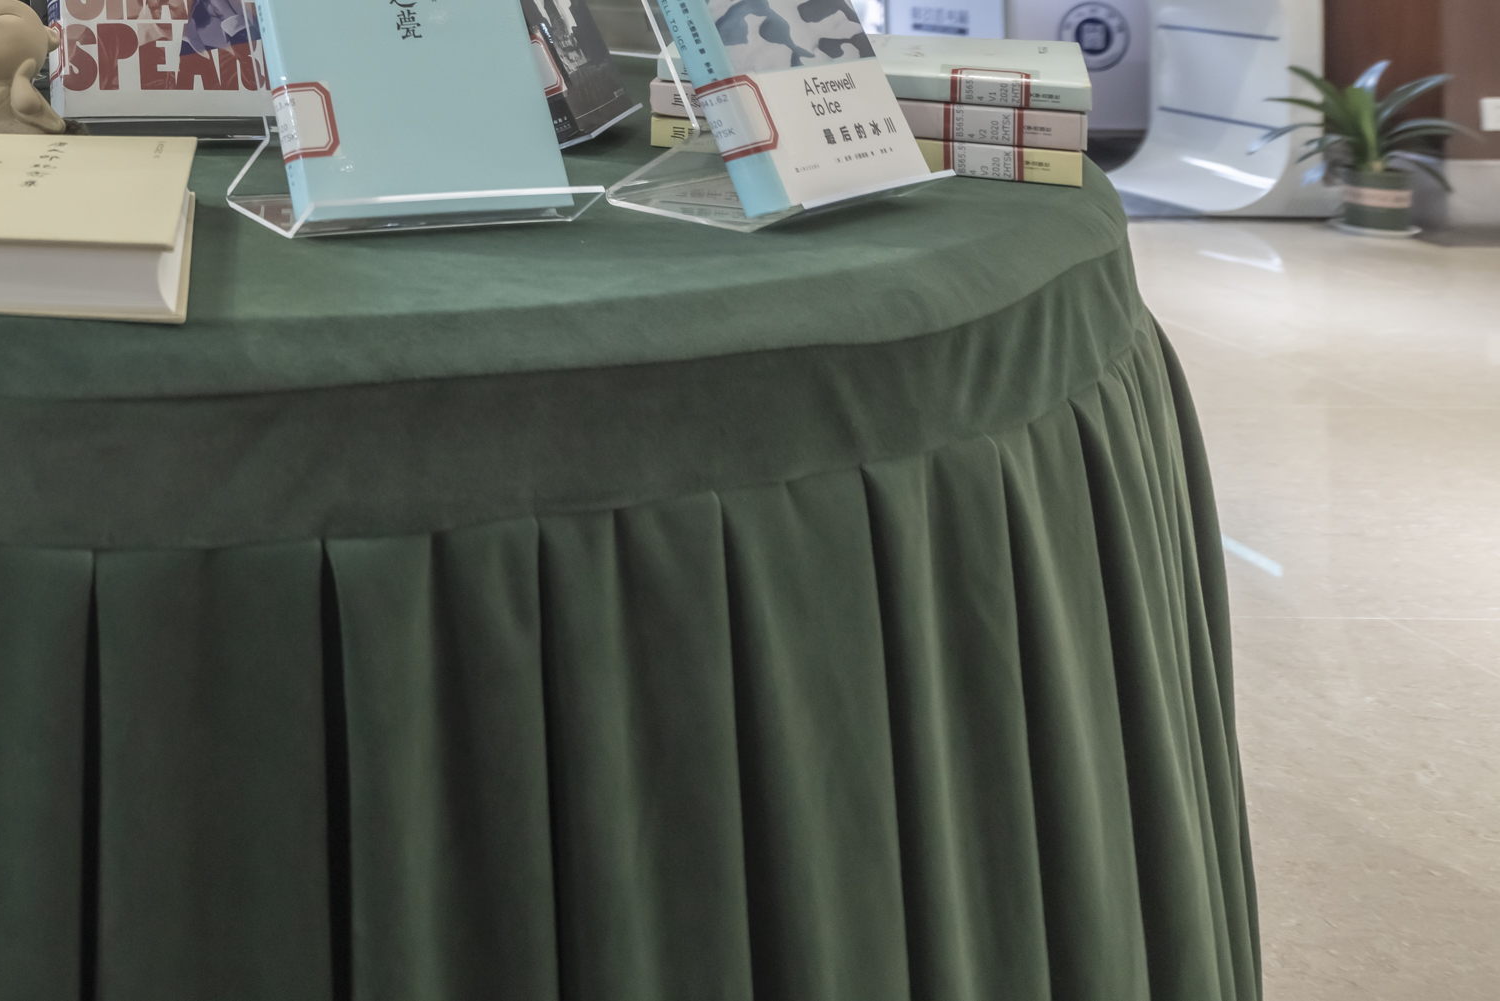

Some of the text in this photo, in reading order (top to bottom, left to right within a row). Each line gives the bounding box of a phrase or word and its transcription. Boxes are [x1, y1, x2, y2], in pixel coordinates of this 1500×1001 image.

[669, 18, 680, 33] TO
[676, 35, 688, 52] ICE
[63, 22, 271, 91] SPEAR
[803, 72, 856, 96] A Farewell
[965, 71, 975, 100] B565.
[1001, 82, 1009, 103] 2020
[810, 97, 842, 117] to Ice
[989, 91, 997, 102] V1
[822, 116, 897, 145] 最后的冰川
[979, 128, 987, 139] V2
[991, 120, 999, 140] 2020
[1002, 114, 1011, 142] ZHTSK
[981, 165, 989, 177] V3
[992, 156, 1000, 177] 2020
[1003, 150, 1012, 178] ZHTSK
